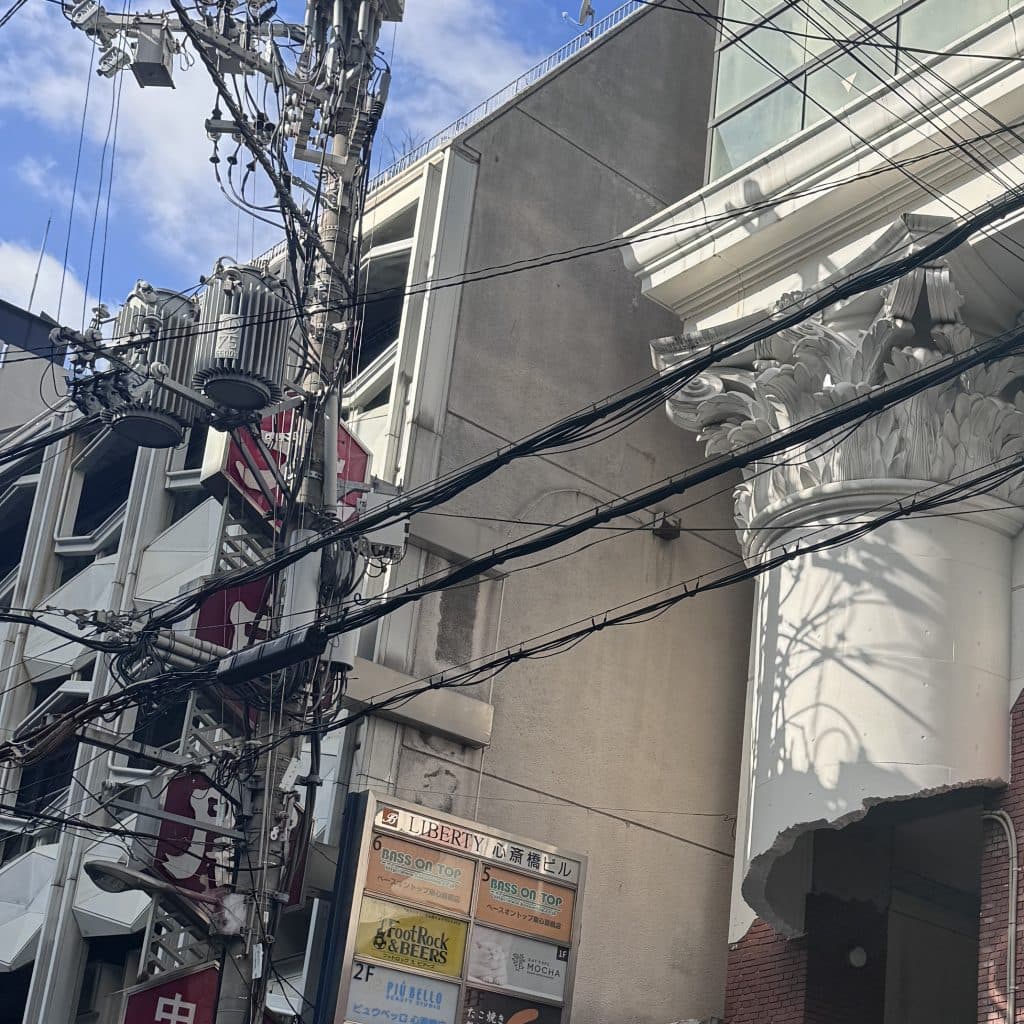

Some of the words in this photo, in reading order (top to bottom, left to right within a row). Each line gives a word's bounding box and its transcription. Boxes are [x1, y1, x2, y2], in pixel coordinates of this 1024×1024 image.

[373, 835, 382, 851] 6
[408, 815, 485, 853] LIBERTY
[382, 848, 412, 867] BASS
[415, 858, 433, 871] ON
[437, 863, 462, 879] TOP
[492, 841, 572, 878] 心斎橋ビル
[482, 867, 491, 882] 5
[490, 878, 518, 895] BASS
[520, 887, 537, 901] ON
[541, 892, 563, 907] TOP
[385, 918, 450, 951] FootRock
[558, 949, 568, 959] 1F
[353, 963, 376, 983] 2F
[527, 963, 561, 978] MOCHA
[409, 986, 443, 1005] BELLO
[467, 1007, 504, 1024] たこ焼き
